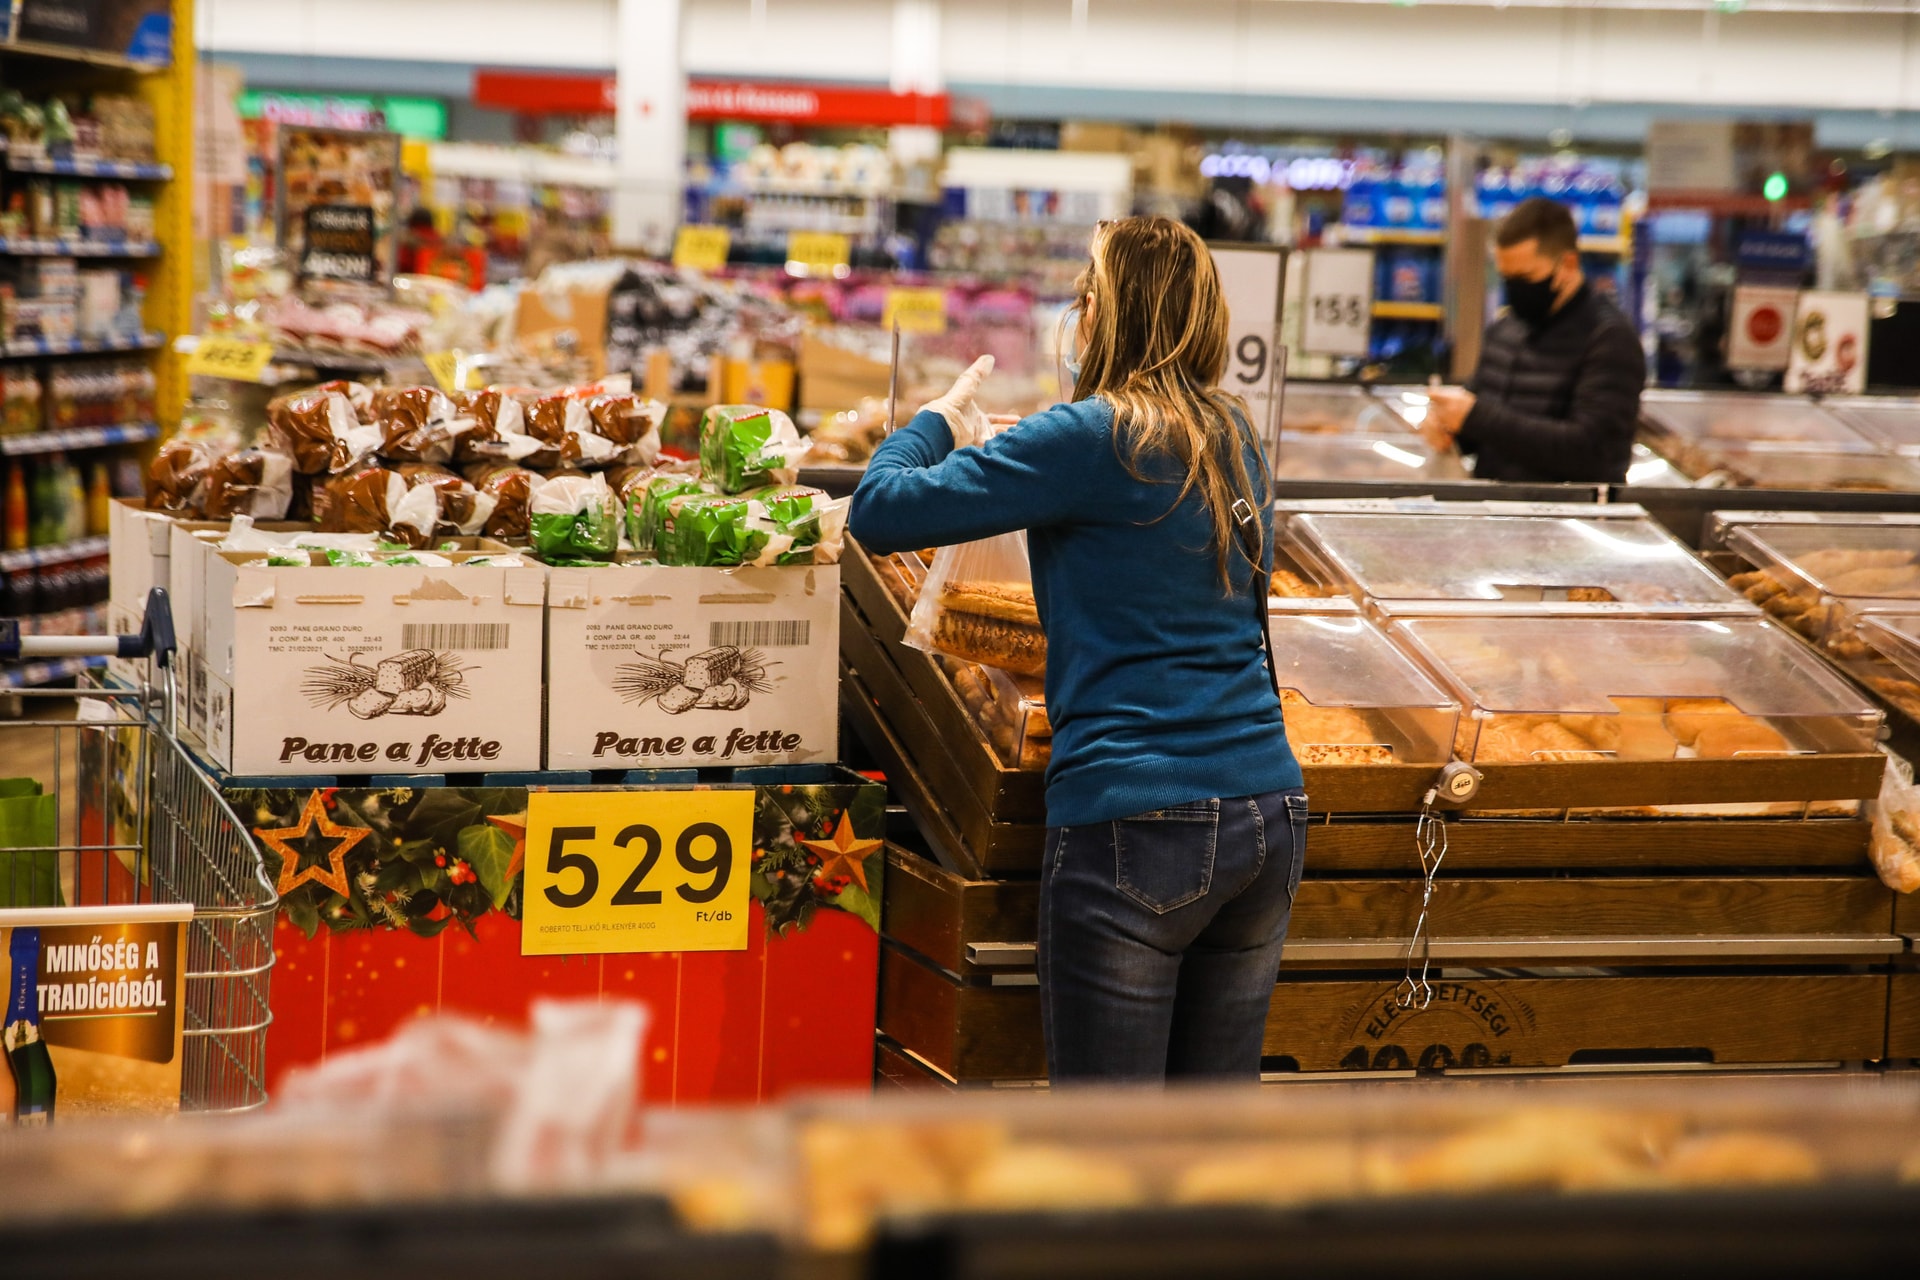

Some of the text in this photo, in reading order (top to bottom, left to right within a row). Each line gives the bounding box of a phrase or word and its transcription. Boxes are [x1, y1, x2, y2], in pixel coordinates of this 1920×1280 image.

[278, 734, 502, 767] Pane a fette
[592, 727, 803, 760] Pane a fette
[543, 822, 733, 908] 529
[540, 925, 571, 934] ROBERTO
[638, 921, 656, 930] 400G
[696, 910, 733, 922] Ft/db
[46, 935, 159, 973] MINŐSÉG A
[37, 973, 167, 1012] TRADÍCIÓBÓL
[1365, 983, 1511, 1040] ELÉGEDETTSÉGI
